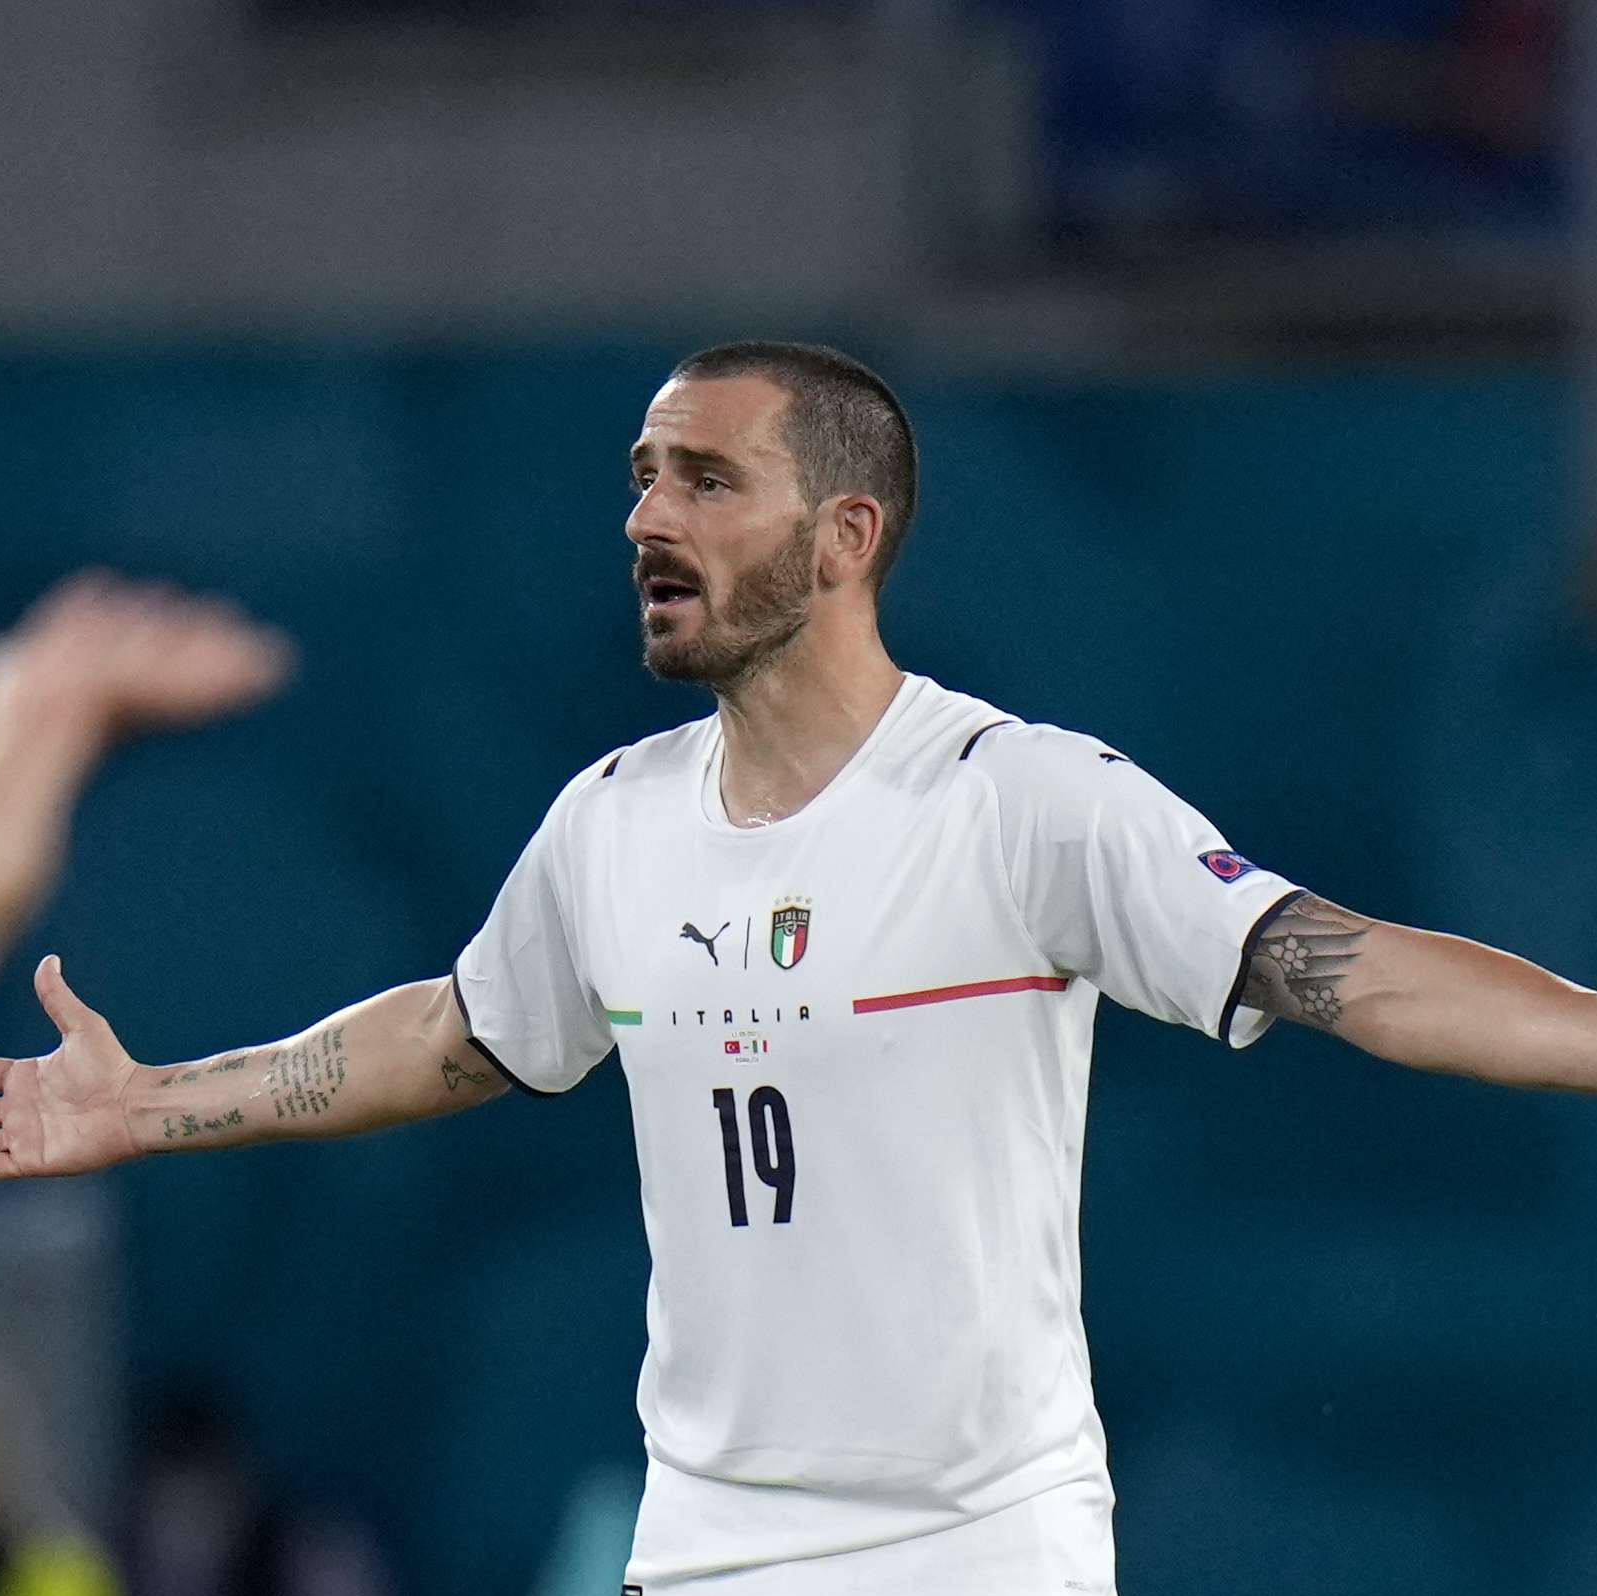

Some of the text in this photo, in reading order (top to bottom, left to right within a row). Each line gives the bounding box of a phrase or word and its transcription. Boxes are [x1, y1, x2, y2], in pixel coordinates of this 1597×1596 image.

[775, 910, 809, 923] ITALIA
[672, 1005, 810, 1025] ITALIA
[713, 1085, 796, 1226] 19
